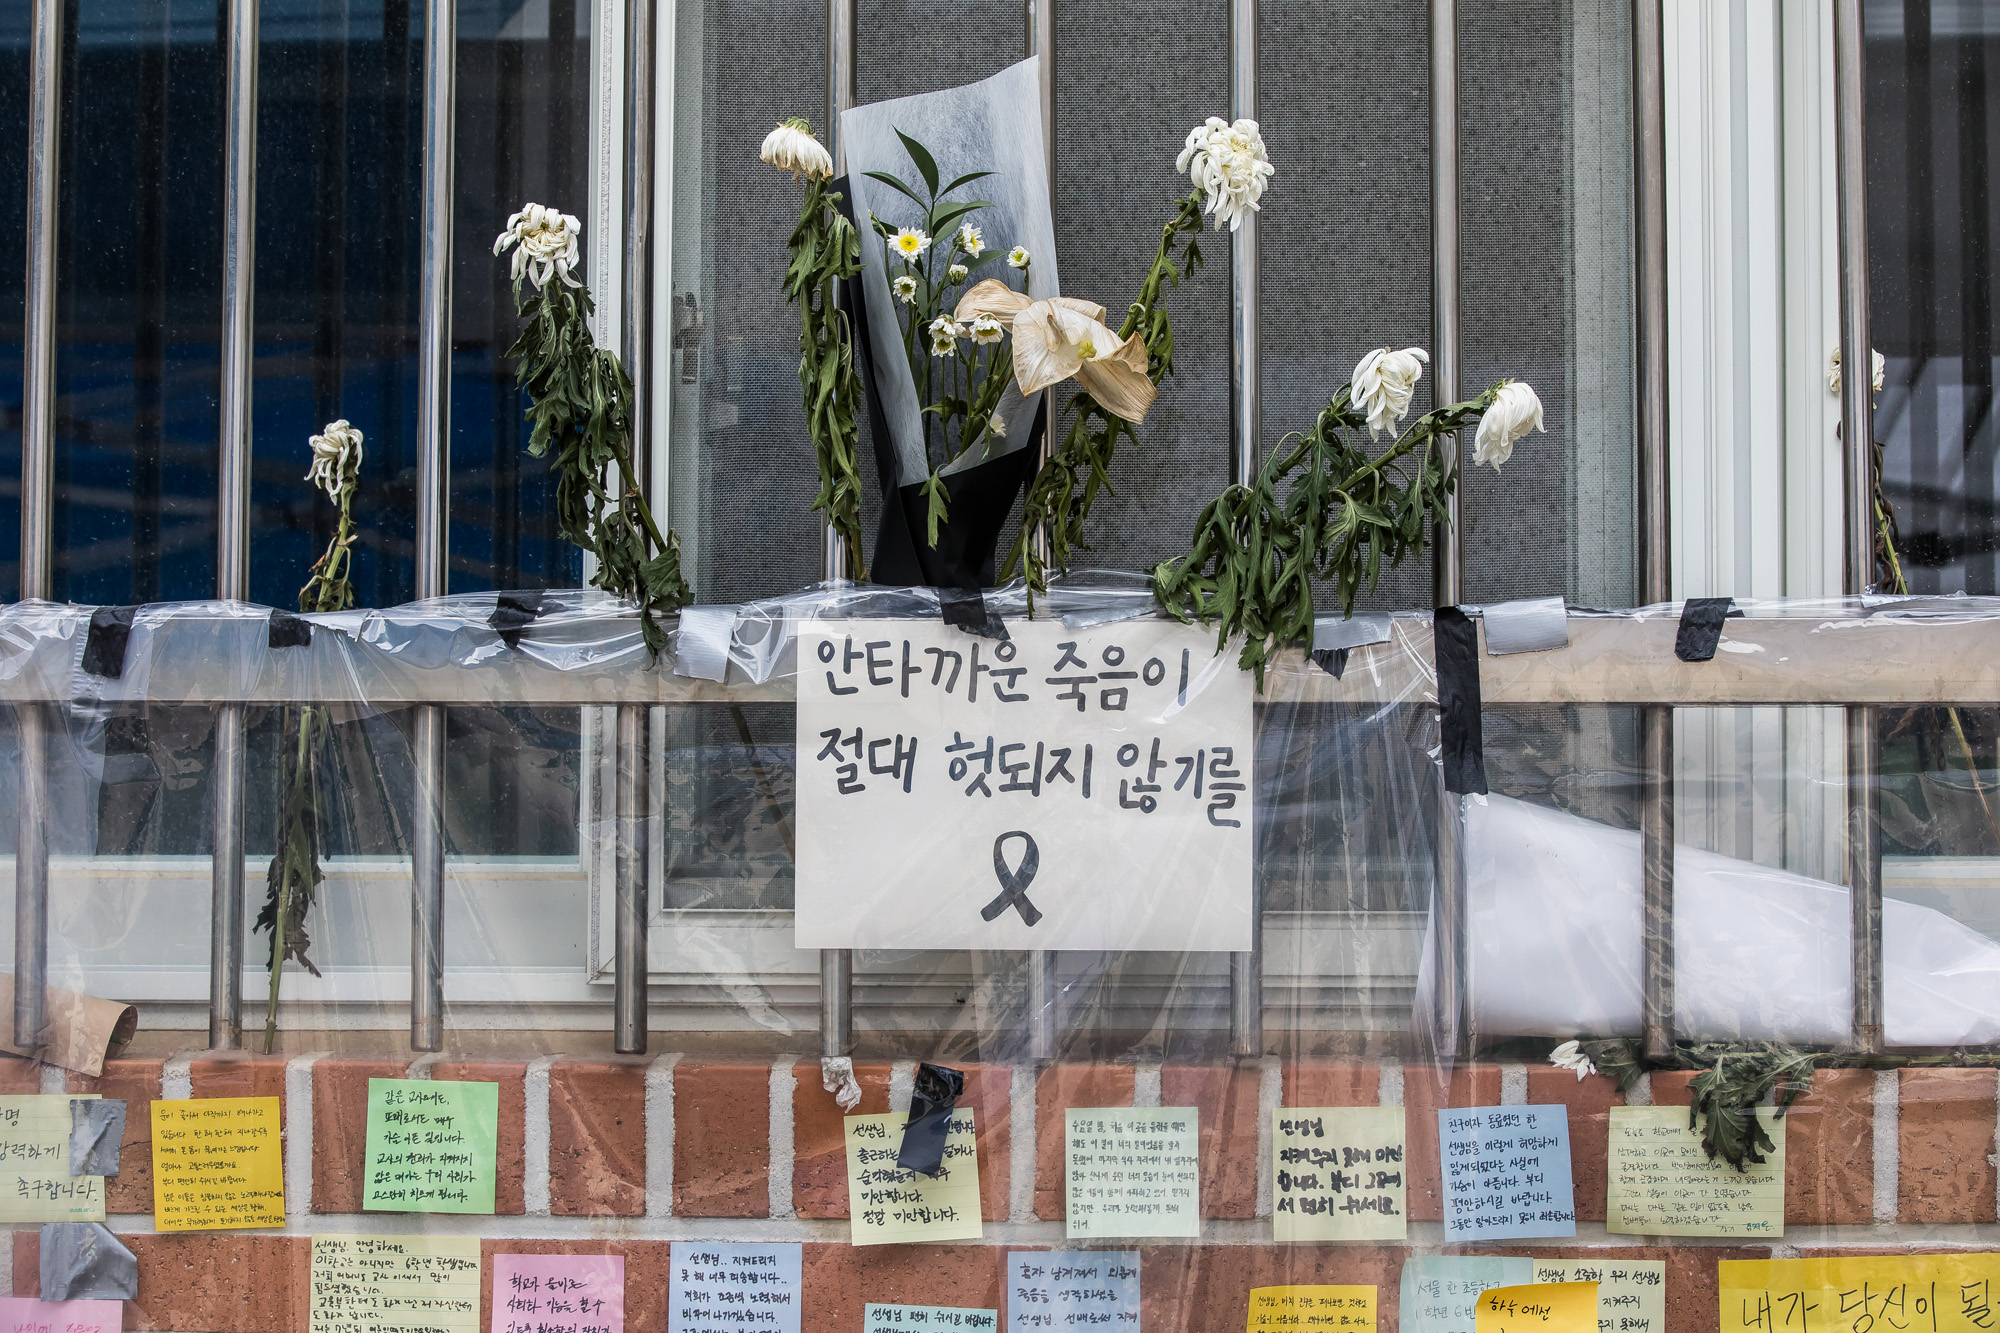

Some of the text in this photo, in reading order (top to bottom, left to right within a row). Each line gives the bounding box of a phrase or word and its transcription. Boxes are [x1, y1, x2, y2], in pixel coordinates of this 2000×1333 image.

[817, 633, 1191, 712] 안타까운 죽음이
[816, 726, 1247, 827] 절대 헛되지 않기를
[385, 1090, 404, 1105] 같은
[1072, 1120, 1093, 1133] 수요일
[1448, 1114, 1537, 1133] 친구이자 동료였던 한
[425, 1131, 465, 1145] 일입니다.
[1449, 1137, 1558, 1156] 선생님을 이렇게 허망하게
[1510, 1157, 1539, 1170] 사실에
[17, 1176, 98, 1200] 촉구합니다.
[1449, 1173, 1543, 1192] 가슴이 아픕니다. 부디
[862, 1188, 923, 1205] 미안합니다.
[1451, 1191, 1552, 1214] 평안하시길 바랍니다.
[863, 1206, 959, 1225] 정말 미안합니다.
[1450, 1218, 1472, 1230] 그동안
[356, 1241, 409, 1254] 안녕하세요.
[360, 1260, 395, 1268] 아니지만
[733, 1255, 776, 1266] 지켜드리지
[314, 1271, 332, 1282] 저희
[430, 1273, 450, 1283] 많이
[709, 1272, 726, 1283] 너무
[1610, 1271, 1628, 1283] 우리
[1017, 1288, 1049, 1303] 죽음을
[1417, 1280, 1457, 1298] 서울 한
[684, 1290, 791, 1304] 저희가 조금씩 노력해서
[1603, 1296, 1641, 1309] 지켜주지
[1743, 1281, 1937, 1333] 내가 당신이
[872, 1308, 902, 1322] 선생님
[935, 1311, 962, 1325] 쉬시길
